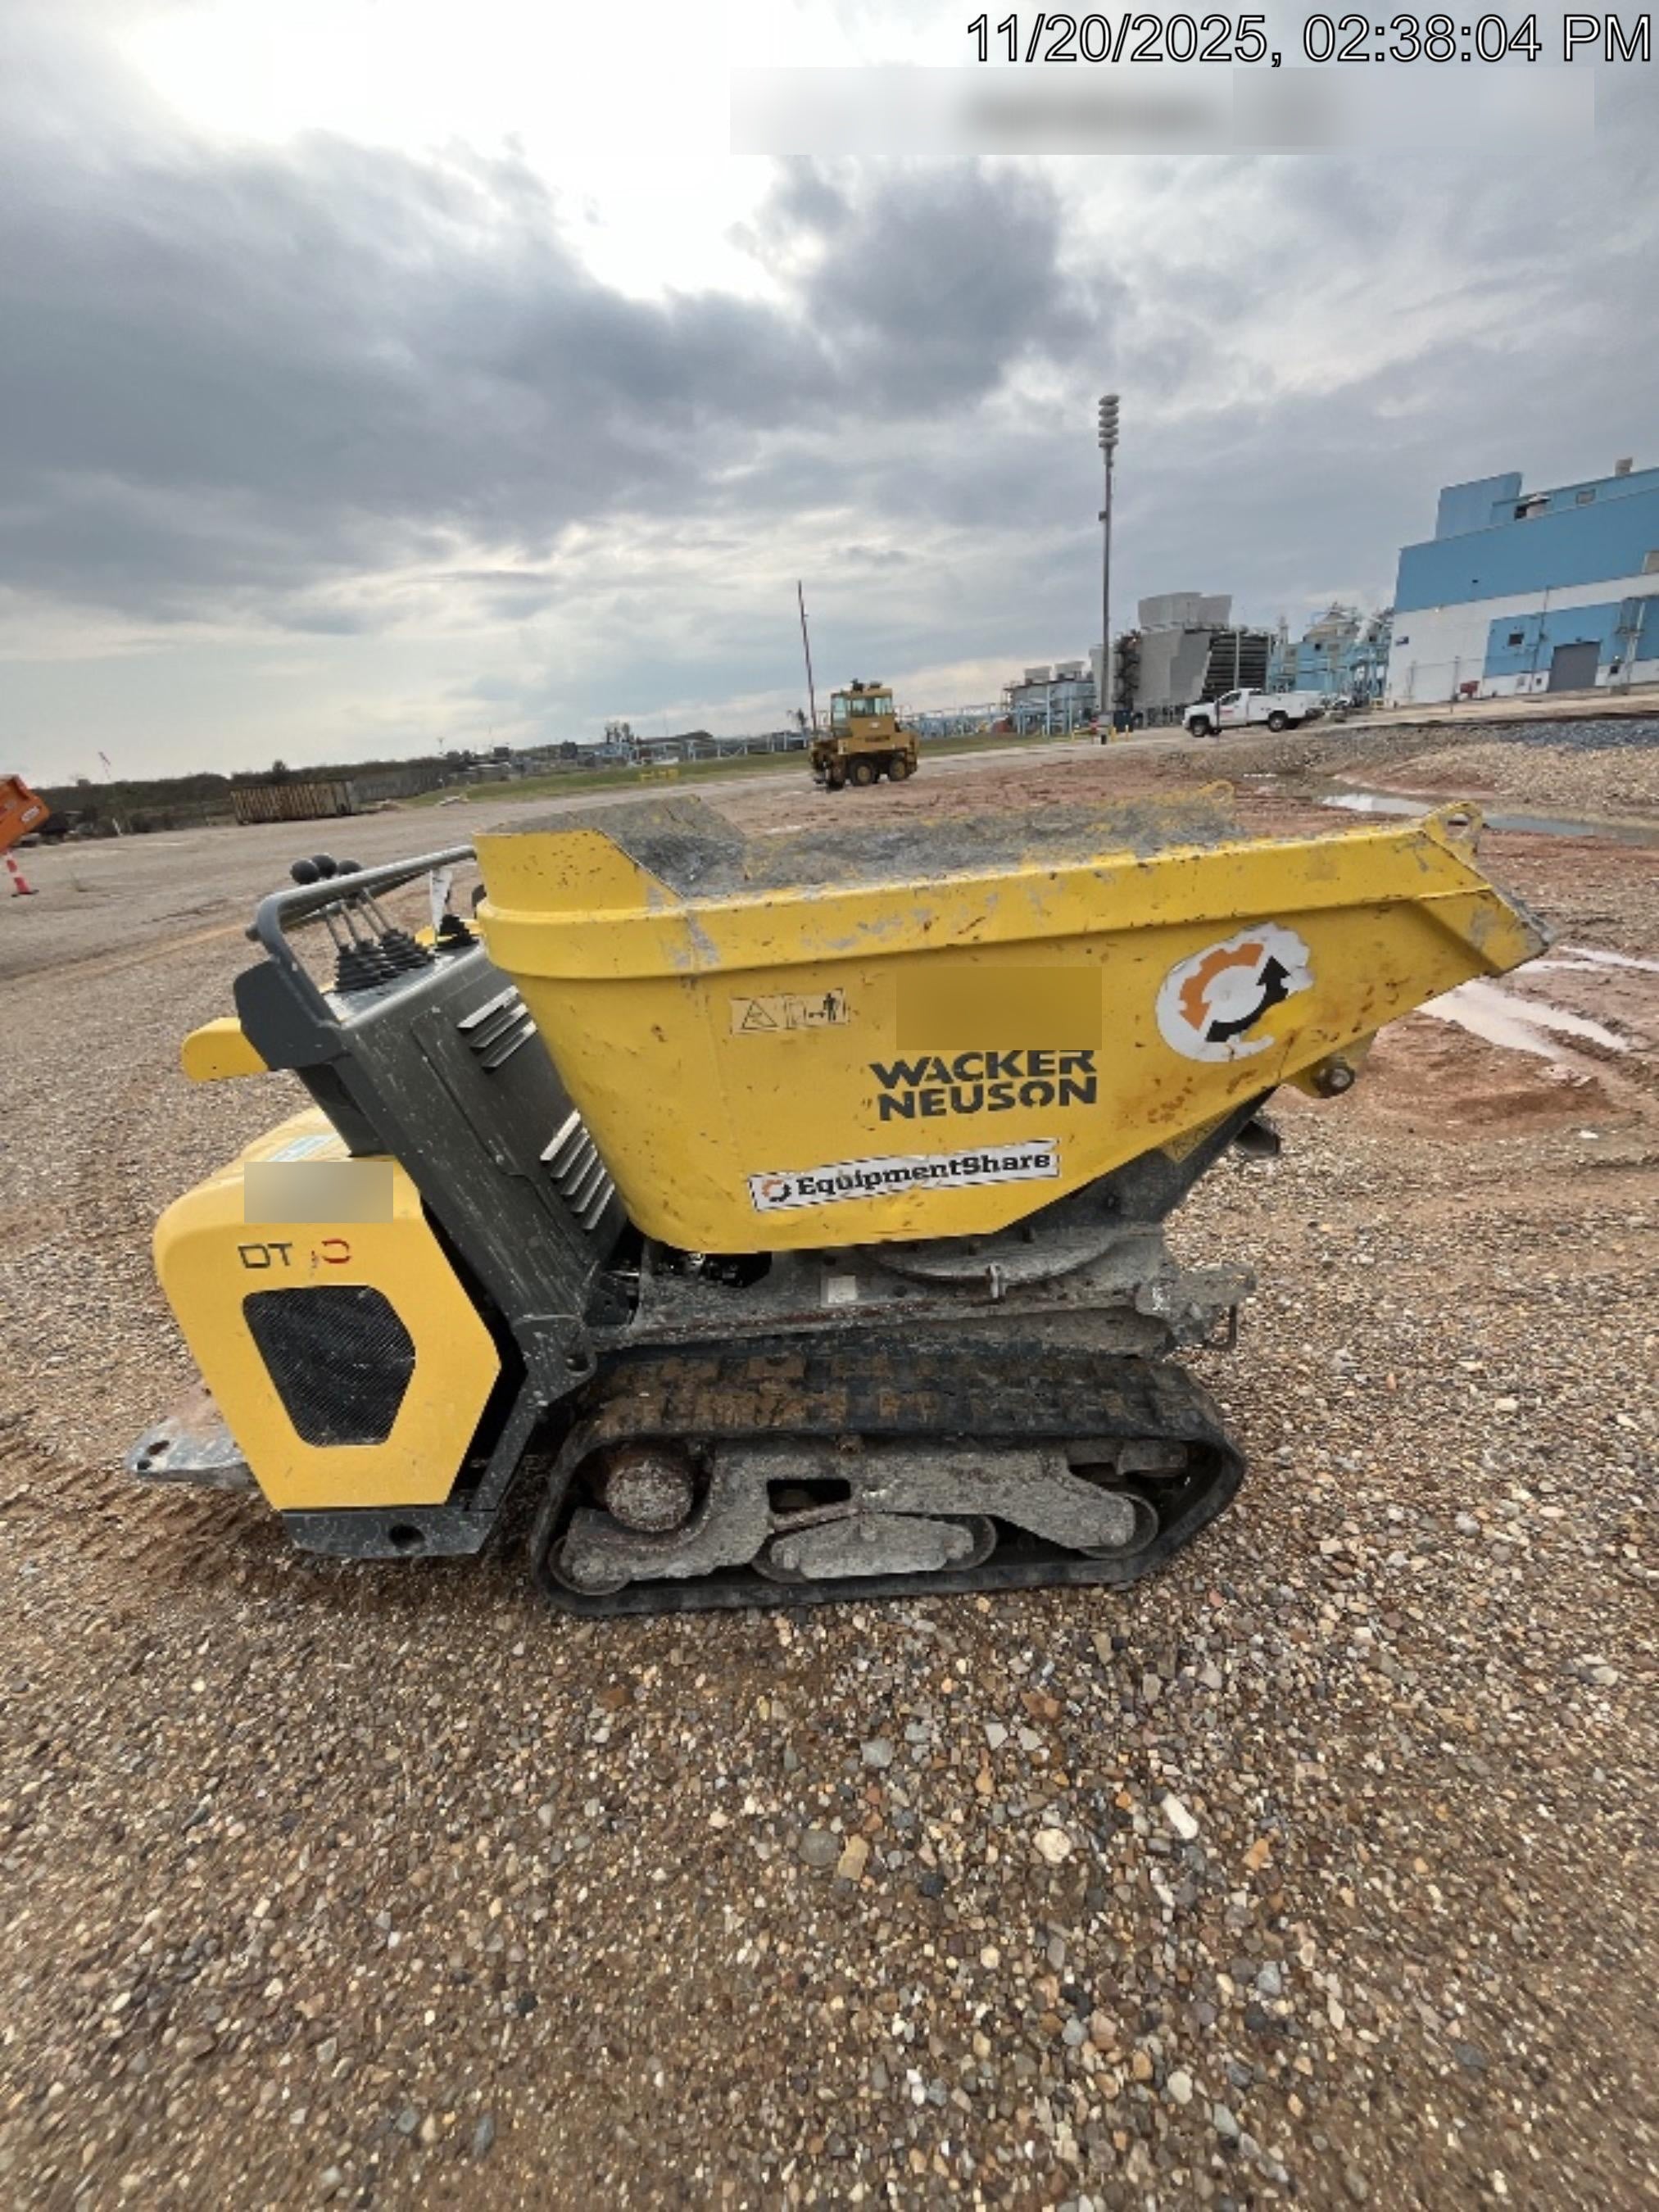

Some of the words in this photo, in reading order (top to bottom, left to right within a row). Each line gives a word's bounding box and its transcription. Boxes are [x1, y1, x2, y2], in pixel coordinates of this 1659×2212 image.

[868, 1050, 1097, 1090] WACKER
[877, 1076, 1097, 1122] NEUSON
[795, 1153, 1051, 1199] EquipmentShare
